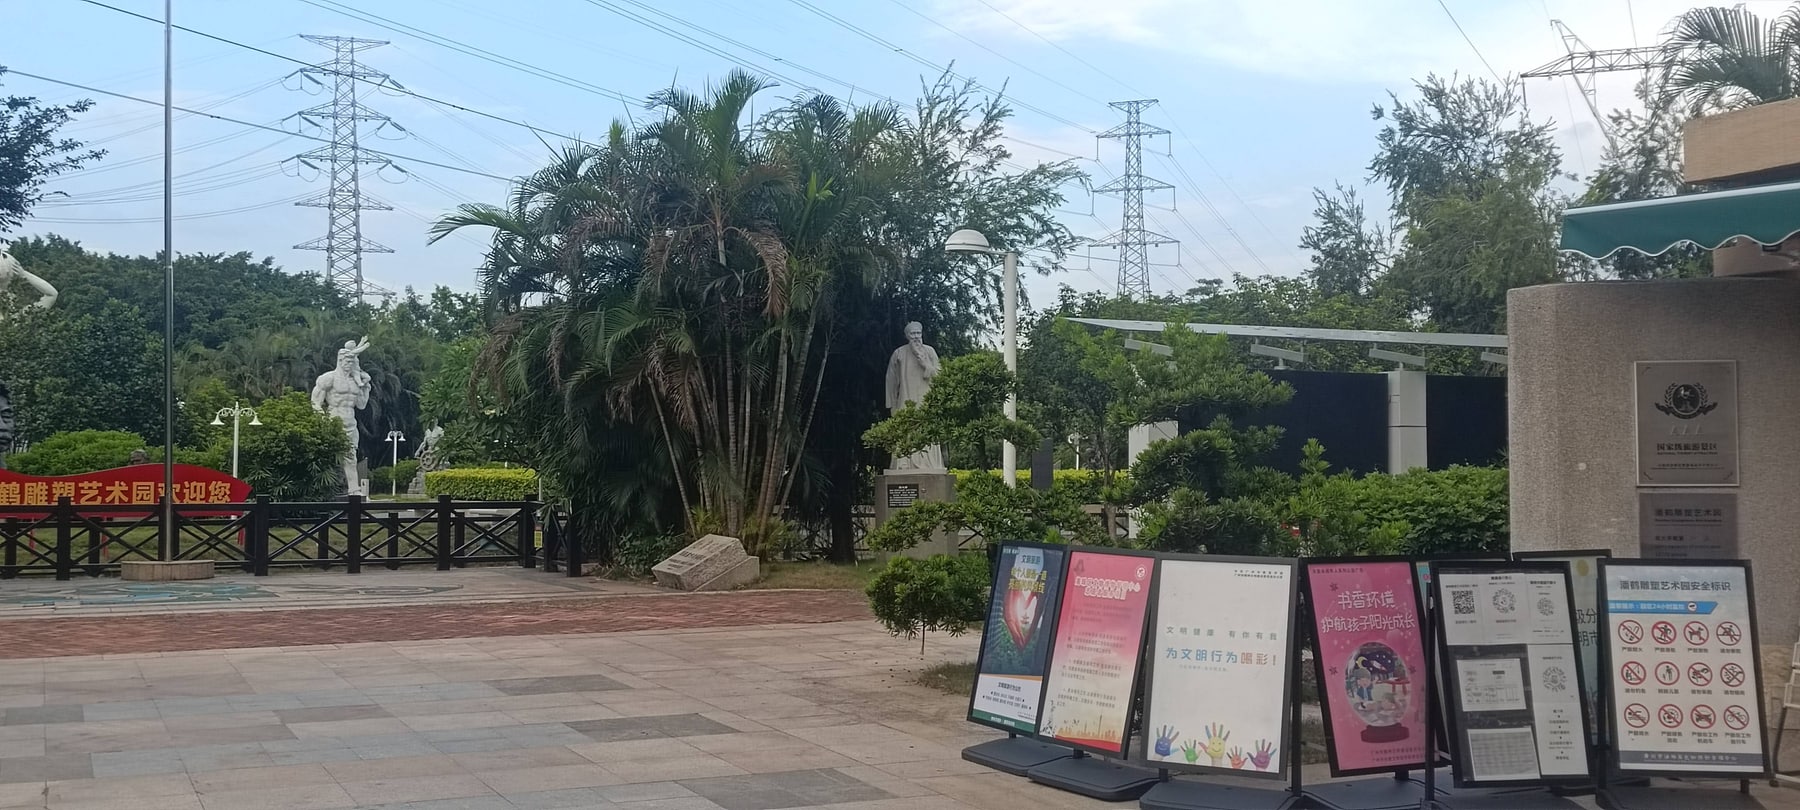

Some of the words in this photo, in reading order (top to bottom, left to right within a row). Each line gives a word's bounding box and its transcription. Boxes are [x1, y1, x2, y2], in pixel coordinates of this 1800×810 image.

[1620, 580, 1731, 591] 潘鹤雕塑艺术园安全标识
[1338, 590, 1396, 609] 书香环境
[1321, 613, 1416, 633] 护航孩子阳光成长
[1166, 647, 1277, 666] 为文明行为喝彩！
